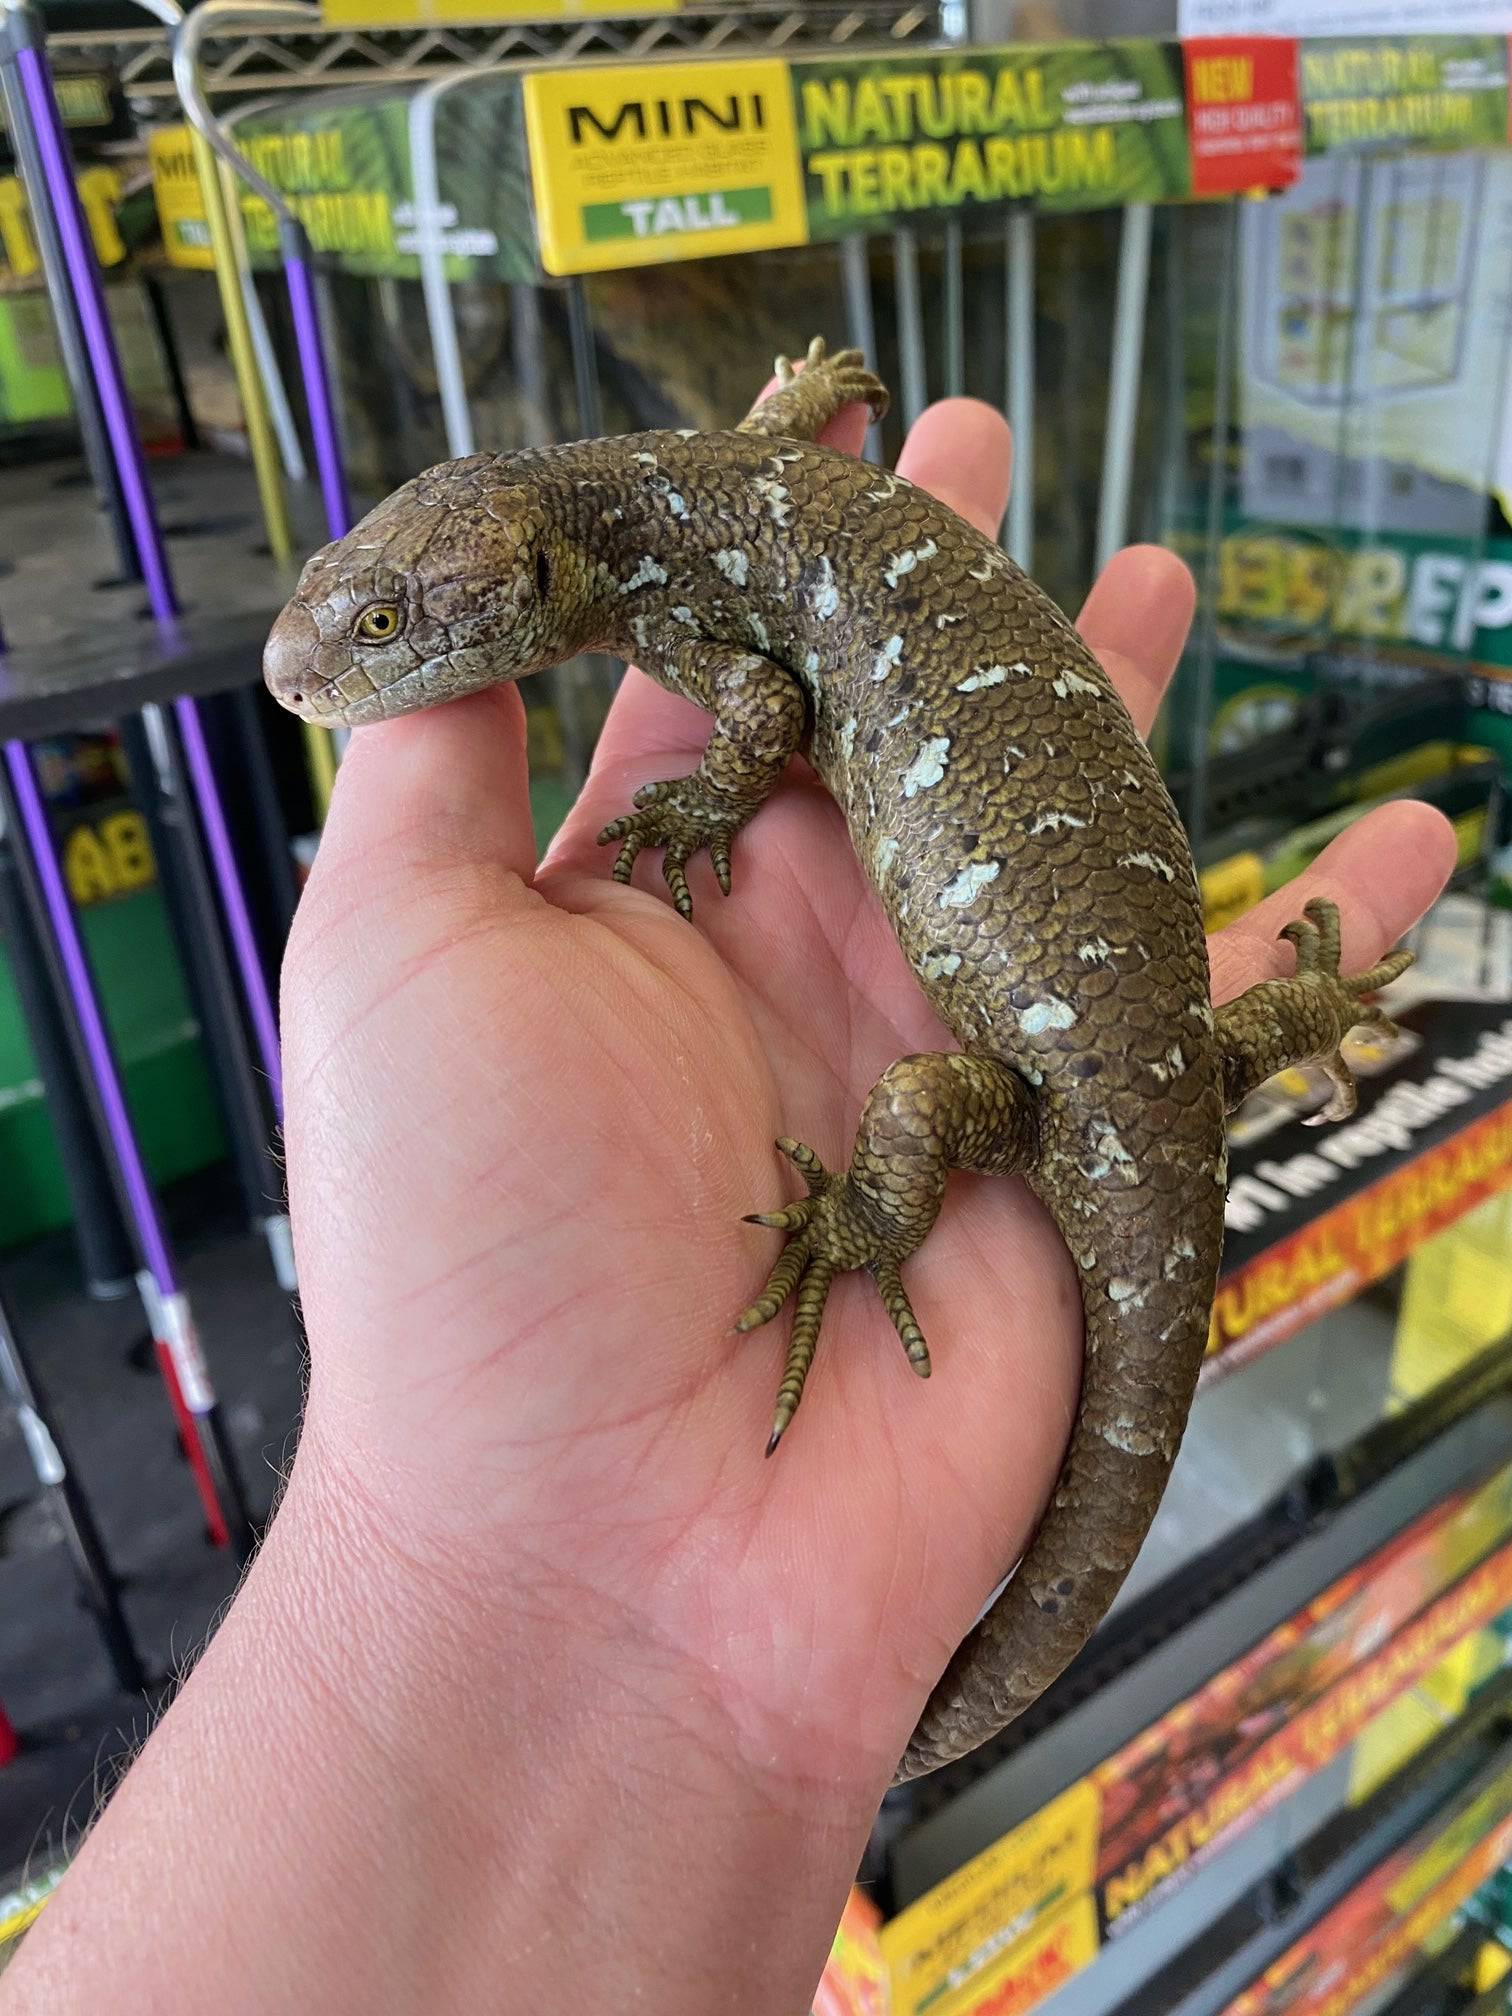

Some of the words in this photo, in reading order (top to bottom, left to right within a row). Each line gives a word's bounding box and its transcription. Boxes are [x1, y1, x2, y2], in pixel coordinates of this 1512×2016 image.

[568, 93, 764, 145] MINI
[801, 67, 1058, 148] NATURAL
[808, 127, 1115, 219] TERRARIUM
[620, 190, 740, 238] TALL
